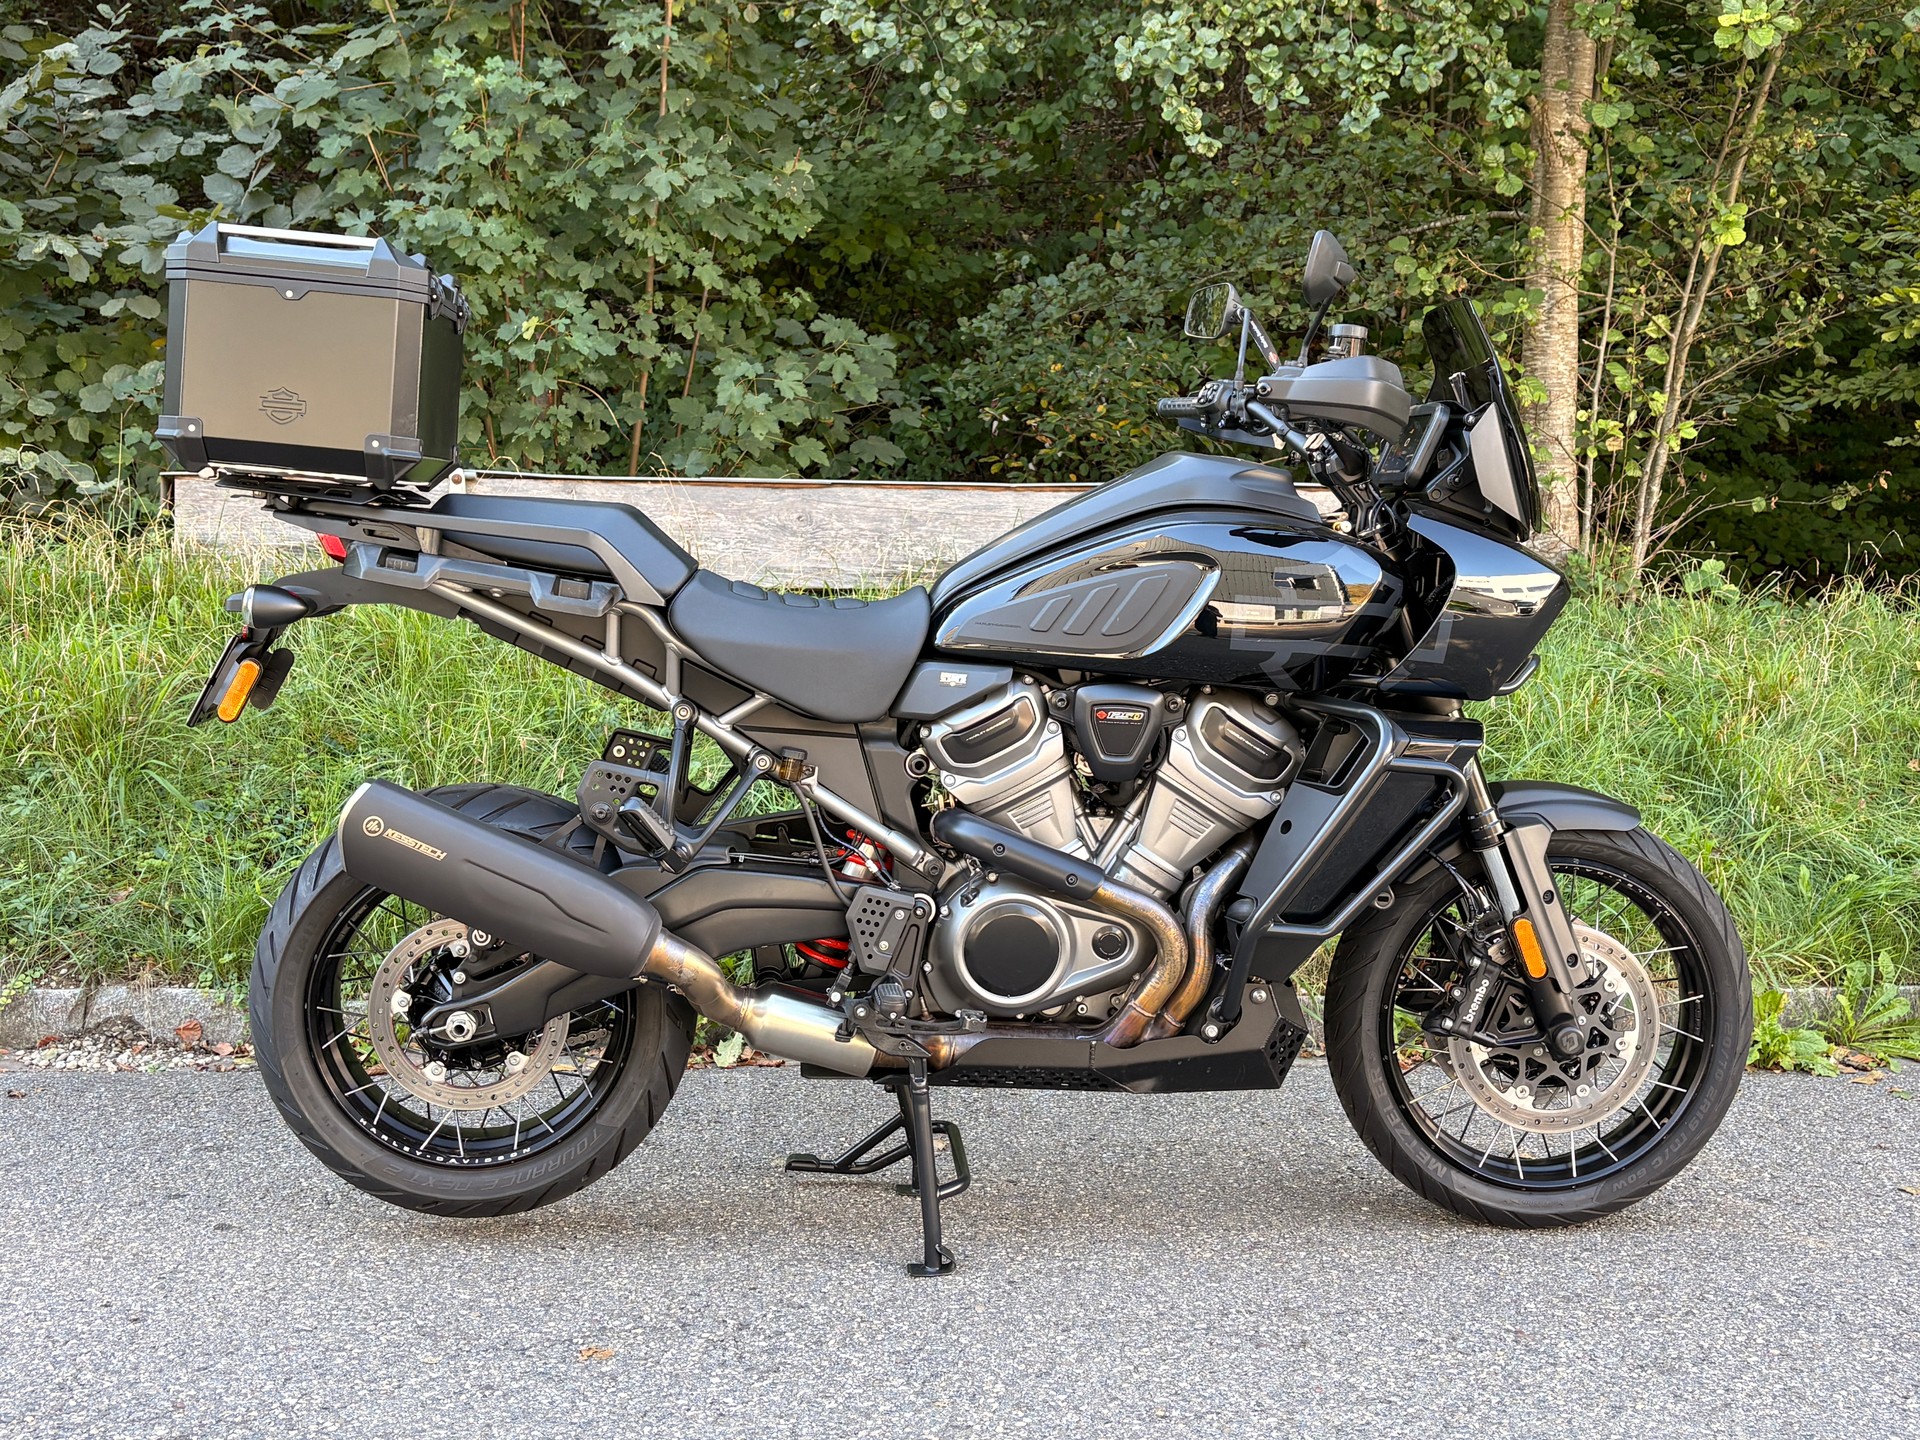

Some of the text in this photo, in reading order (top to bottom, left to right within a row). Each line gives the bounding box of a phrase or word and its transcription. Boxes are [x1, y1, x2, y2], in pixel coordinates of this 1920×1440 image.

[382, 827, 448, 862] KESSTECH
[1462, 978, 1491, 1023] brembo
[359, 1117, 531, 1164] HARLEY-DAVIDSON
[1367, 1067, 1448, 1179] METZELER
[480, 1127, 602, 1192] TOURANCE
